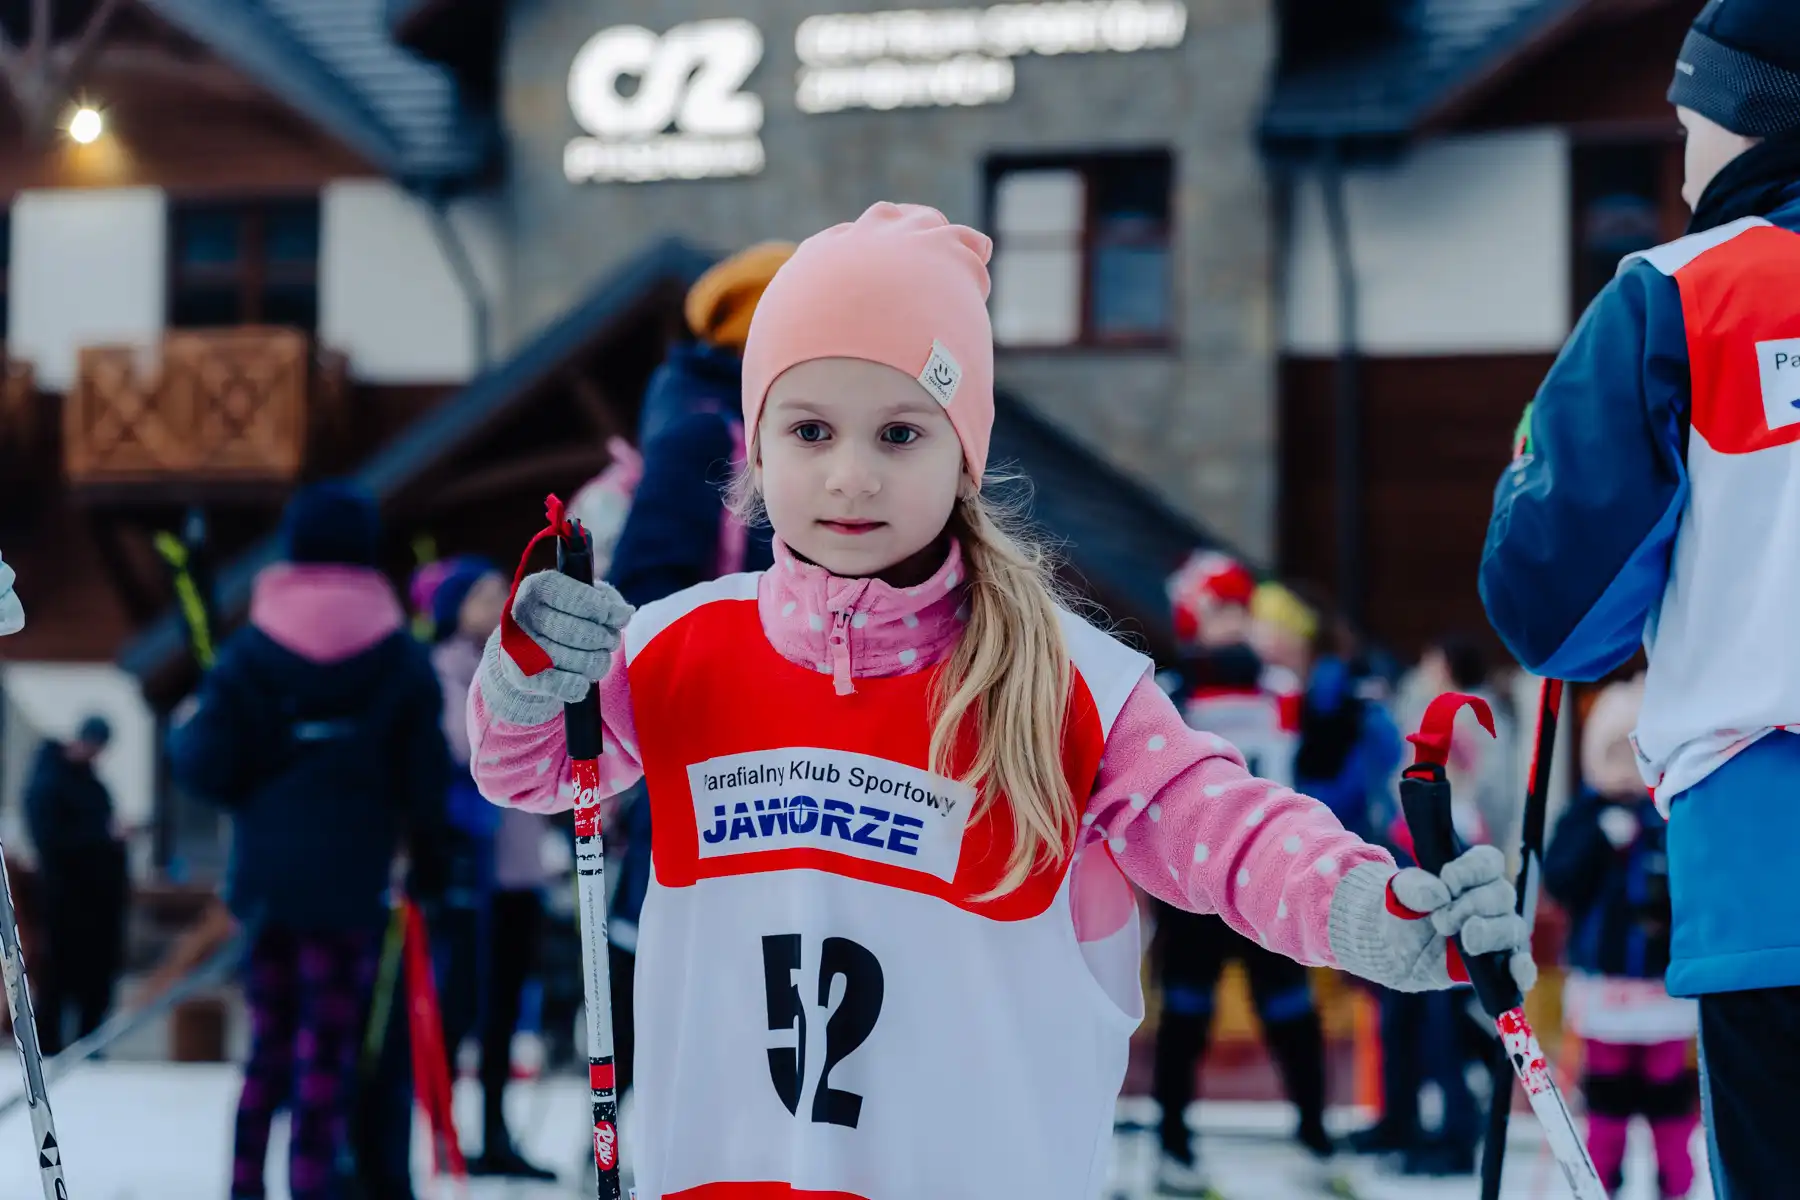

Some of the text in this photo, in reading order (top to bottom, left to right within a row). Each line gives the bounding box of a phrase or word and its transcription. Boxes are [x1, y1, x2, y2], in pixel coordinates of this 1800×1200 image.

[789, 760, 841, 784] Klub
[848, 767, 957, 818] Sportowy
[703, 795, 924, 856] JAWORZE
[762, 933, 884, 1129] 52
